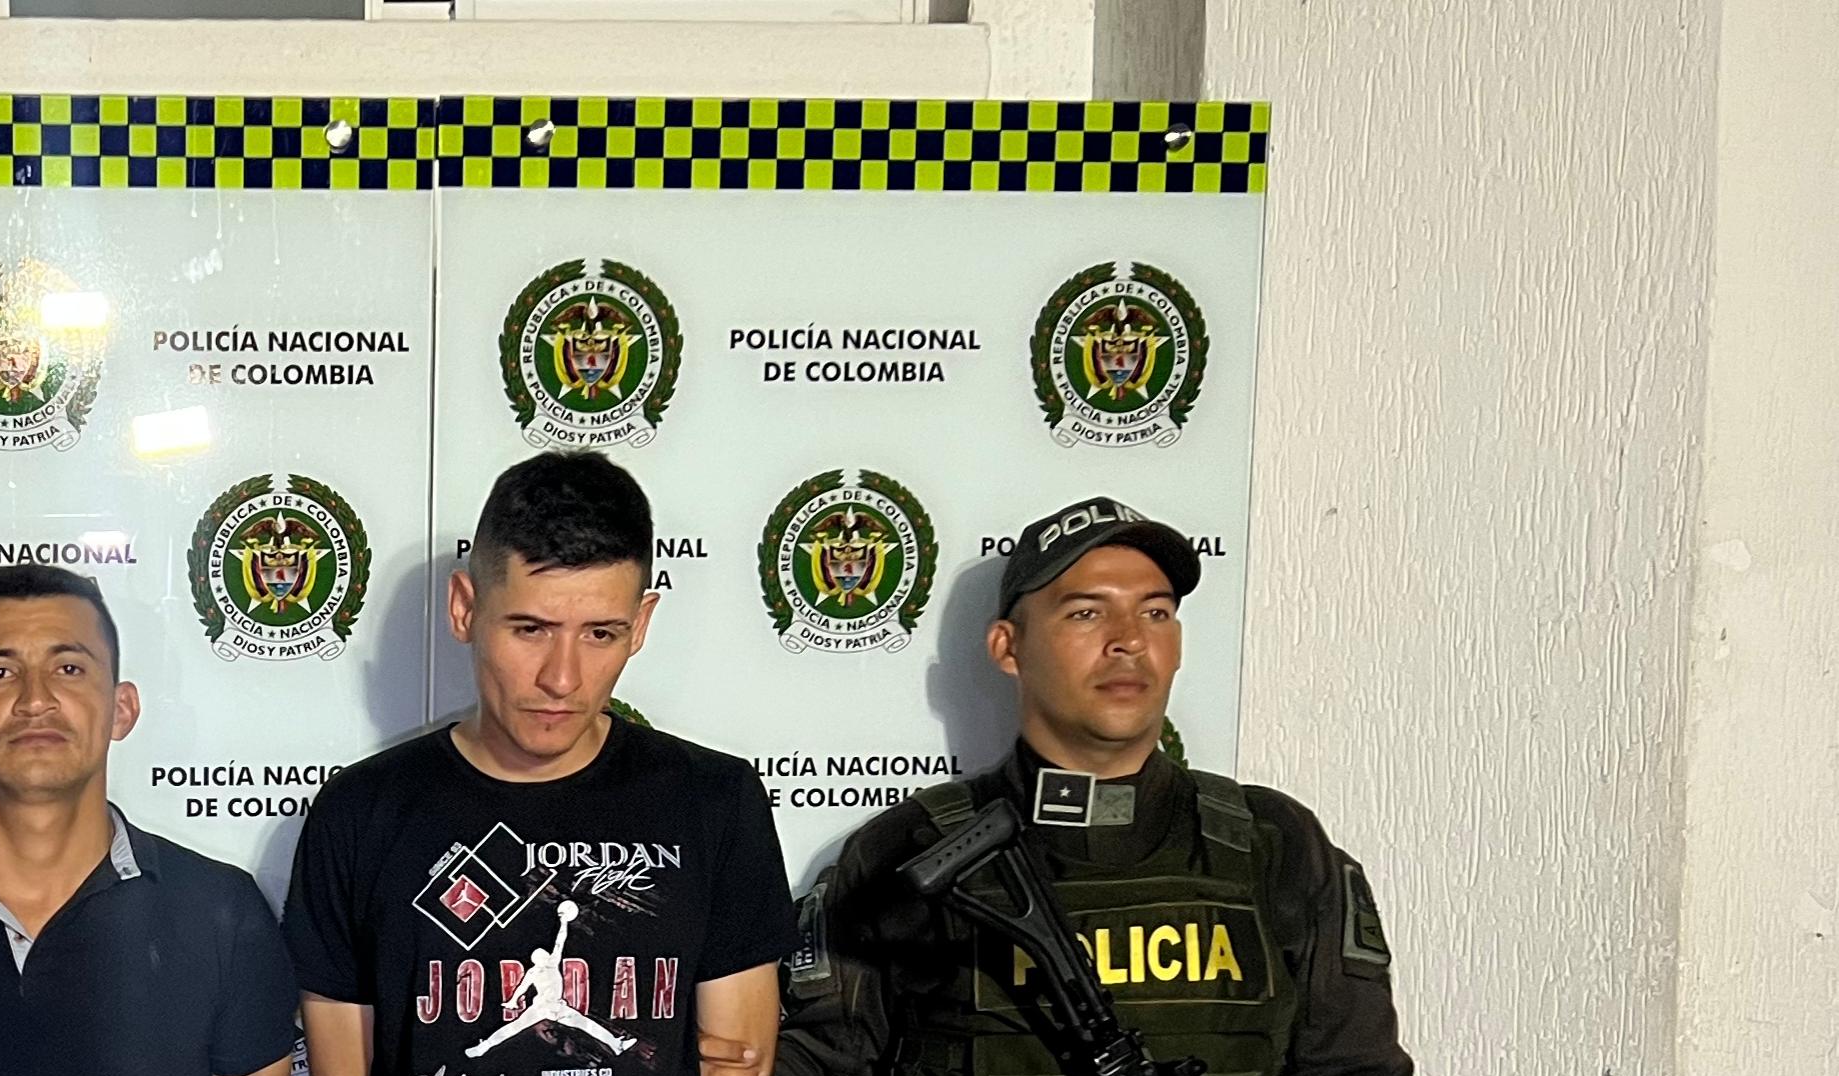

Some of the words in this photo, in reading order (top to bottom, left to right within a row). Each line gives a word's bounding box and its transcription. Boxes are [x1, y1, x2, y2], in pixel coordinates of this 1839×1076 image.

[585, 281, 604, 291] DE
[619, 289, 660, 363] COLOMBIA
[730, 323, 832, 349] POLICÍA
[843, 330, 980, 349] NACIONAL
[1115, 283, 1134, 293] DE
[1148, 292, 1186, 365] COLOMBIA
[153, 325, 259, 352] POLICÍA
[267, 331, 410, 353] NACIONAL
[232, 365, 373, 384] COLOMBIA
[764, 362, 795, 381] DE
[806, 362, 944, 381] COLOMBIA
[591, 381, 653, 426] NACIONAL
[1118, 382, 1179, 426] NACIONAL
[13, 425, 61, 446] PATRIA
[590, 422, 637, 443] PATRIA
[1116, 422, 1163, 443] PATRIA
[273, 495, 292, 506] DE
[307, 504, 348, 577] COLOMBIA
[843, 490, 861, 501] DE
[876, 499, 915, 571] COLOMBIA
[281, 595, 341, 639] NACIONAL
[847, 588, 908, 631] NACIONAL
[279, 635, 326, 656] PATRIA
[846, 628, 892, 649] PATRIA
[152, 760, 254, 786] POLICÍA
[753, 751, 817, 778] LICÍA
[827, 755, 962, 776] NACIONAL
[187, 799, 217, 817] DE
[521, 841, 681, 876] JORDAN
[571, 858, 655, 894] Flight
[1013, 923, 1243, 985] PLICIA
